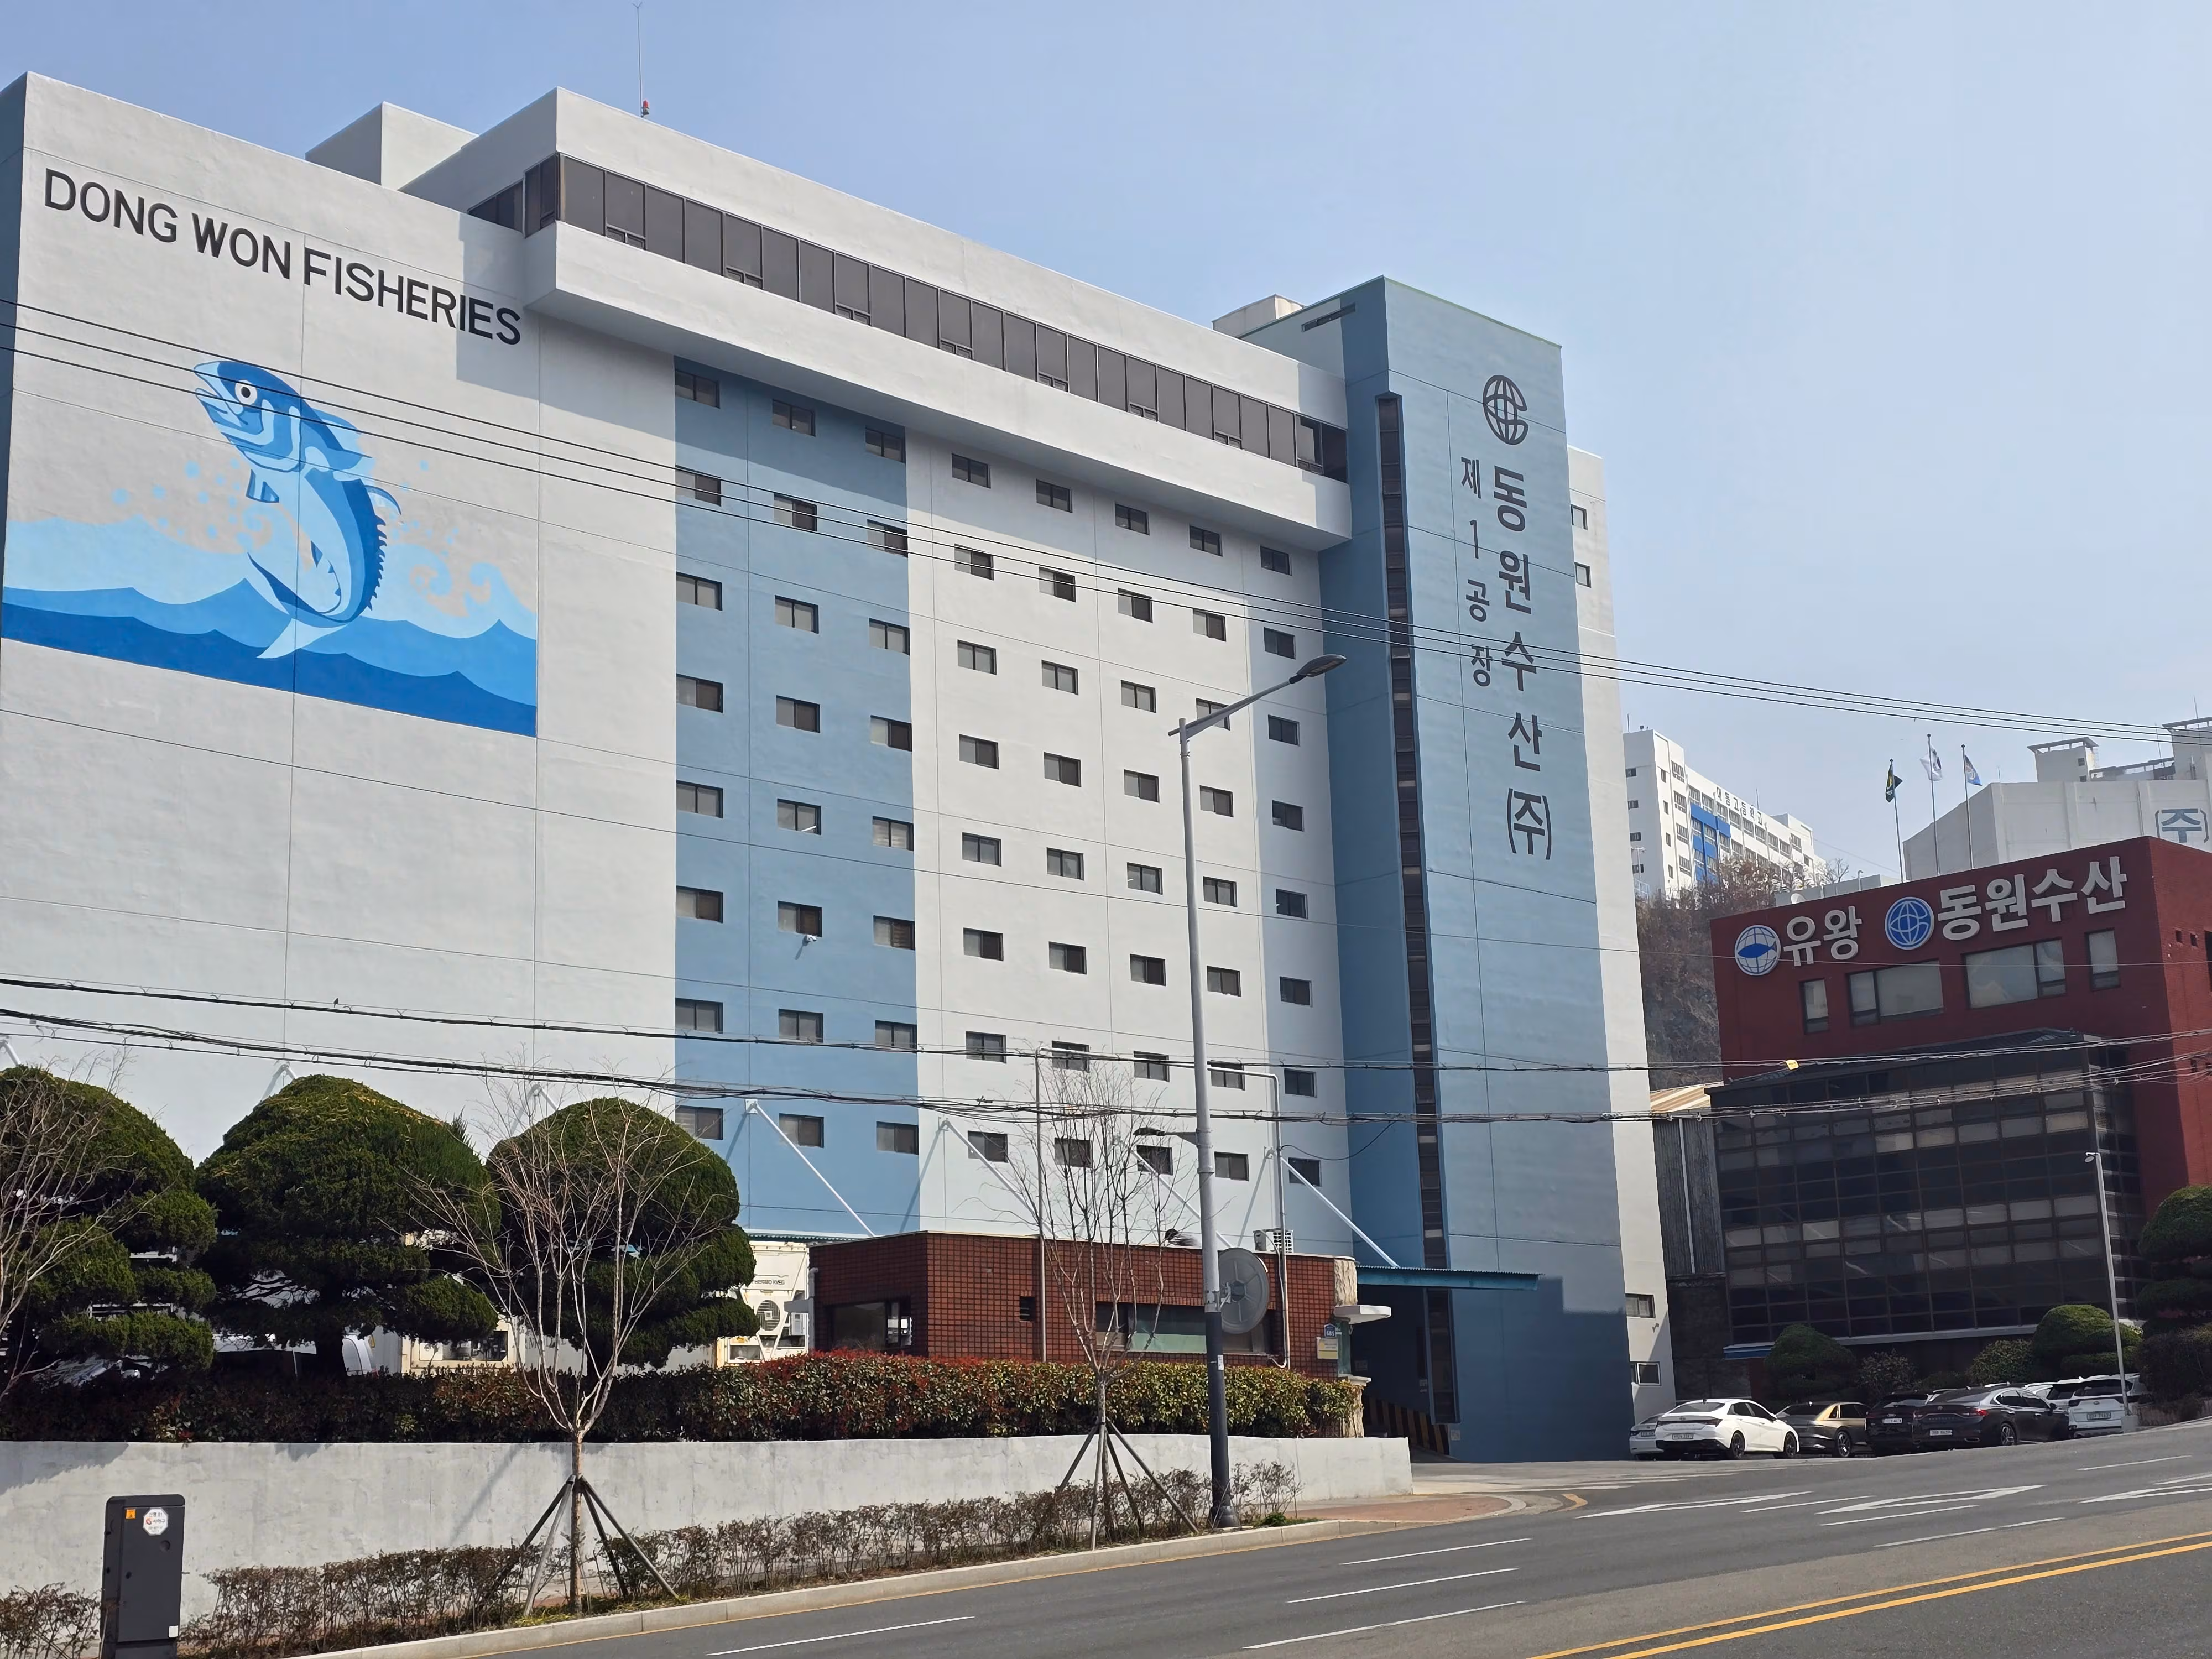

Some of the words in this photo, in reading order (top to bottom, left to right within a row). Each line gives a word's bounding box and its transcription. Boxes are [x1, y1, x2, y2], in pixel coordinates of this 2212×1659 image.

[44, 168, 178, 243] DONG
[191, 212, 291, 280] WON
[304, 247, 521, 346] FISHERIES
[1717, 786, 1763, 826] 대동고등학교
[1937, 856, 2127, 941] 동원수산
[1783, 906, 1863, 967] 유왕
